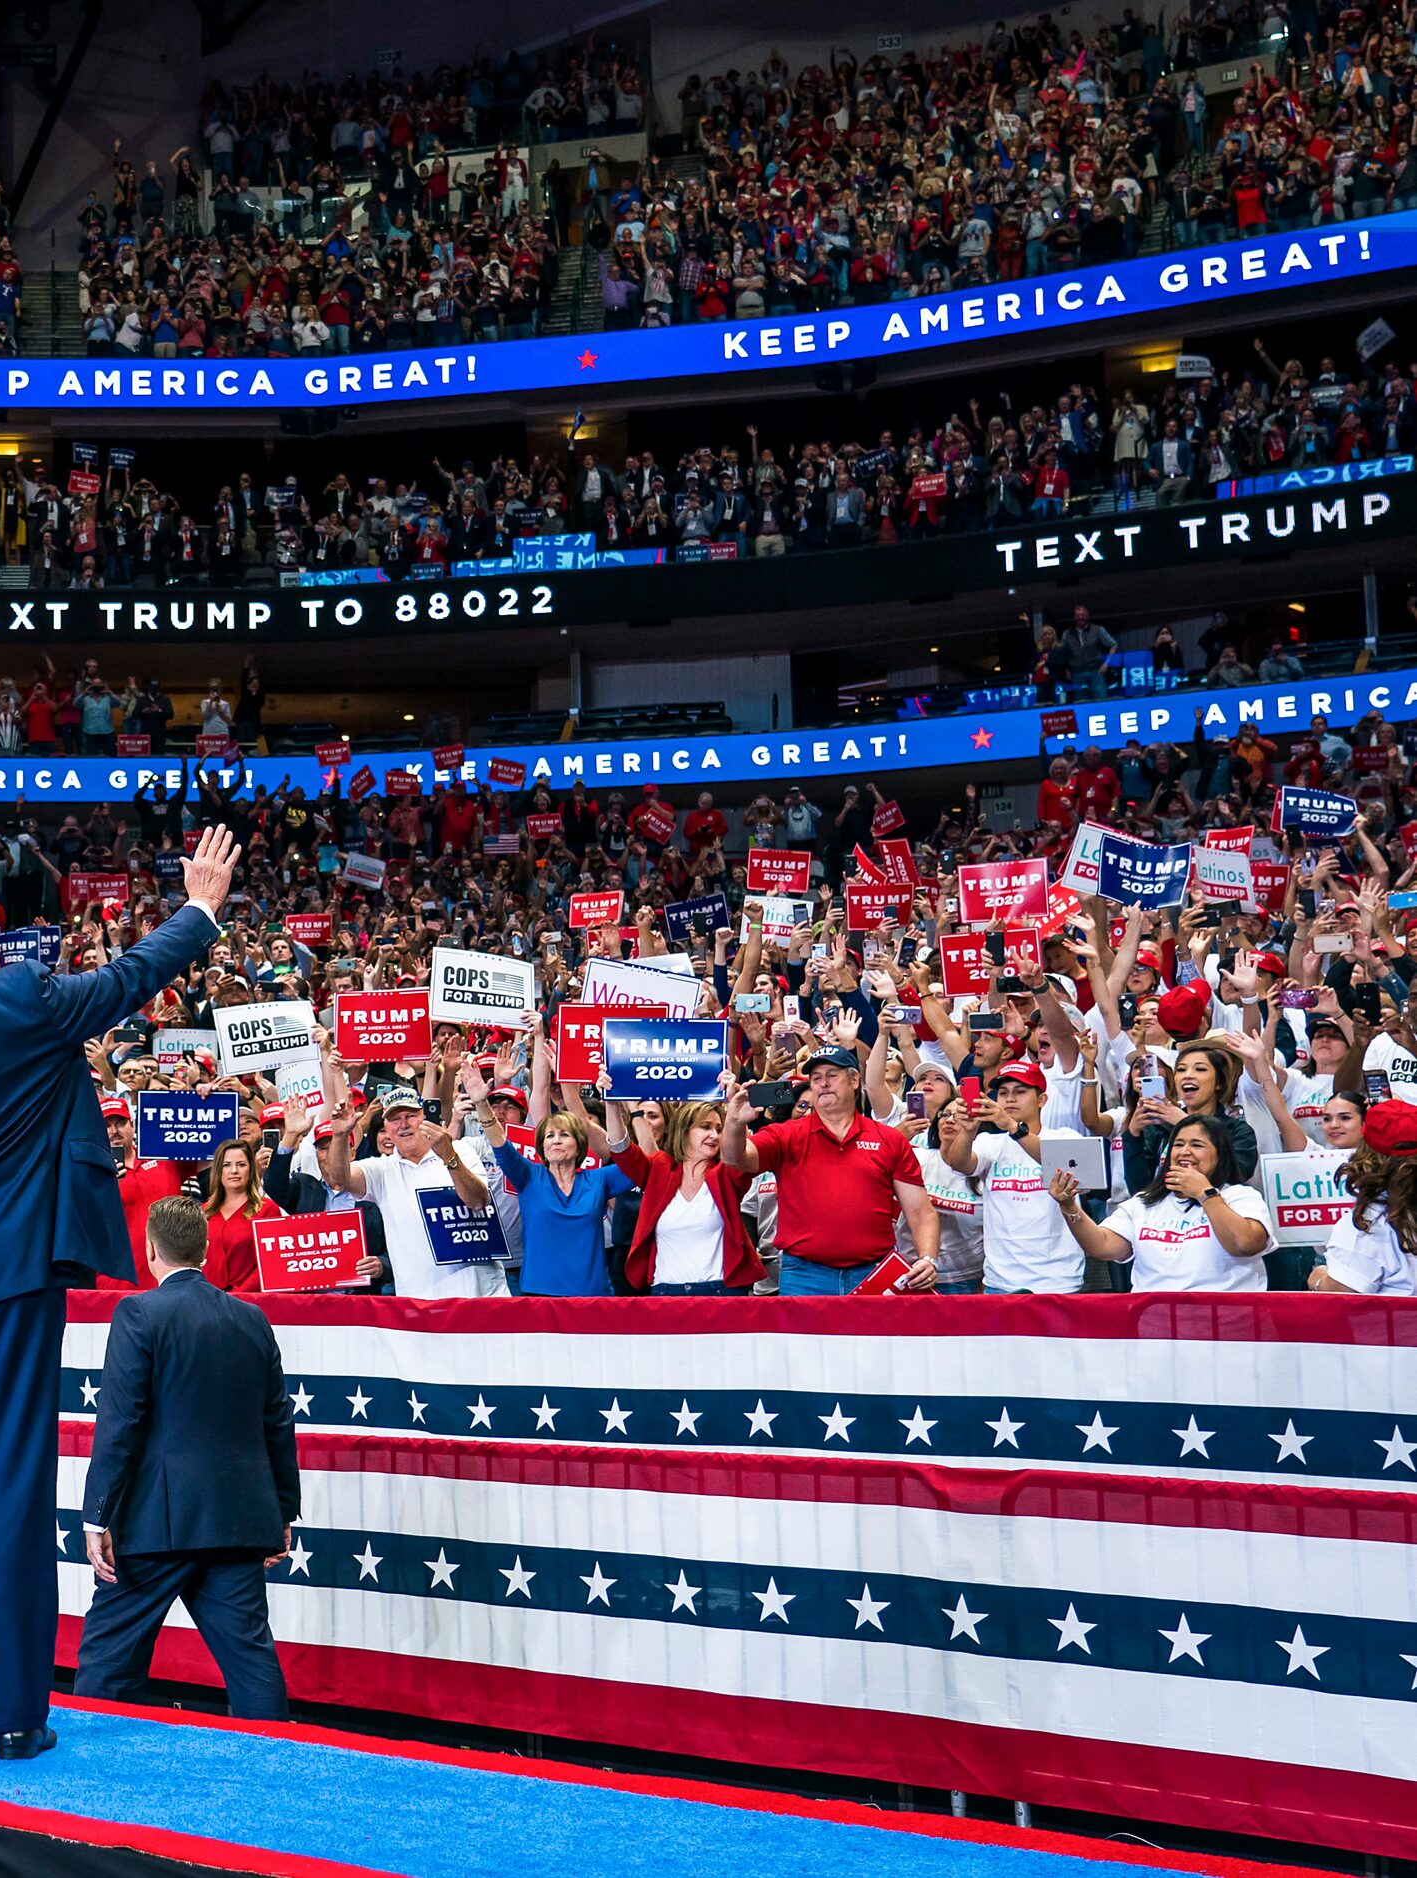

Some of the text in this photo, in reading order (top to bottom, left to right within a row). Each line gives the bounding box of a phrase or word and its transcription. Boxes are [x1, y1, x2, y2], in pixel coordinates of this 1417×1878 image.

[879, 36, 901, 49] 333
[724, 230, 1369, 359] KEEP AMERICA GREAT!
[58, 370, 274, 395] AMERICA
[305, 356, 476, 394] GREAT!
[996, 493, 1390, 572] TEXT TRUMP
[99, 602, 271, 630] TRUMP
[301, 598, 362, 627] TO
[395, 586, 552, 622] 88022
[533, 734, 907, 777] AMERICA GREAT!
[995, 801, 1012, 811] 124
[1286, 796, 1354, 811] TRUMP
[1301, 813, 1338, 824] 2020
[1209, 836, 1251, 850] TRUMP
[752, 859, 806, 870] TRUMP
[1104, 852, 1187, 875] TRUMP
[763, 873, 793, 883] 2020
[964, 873, 1042, 891] TRUMP
[1121, 879, 1165, 894] 2020
[1213, 885, 1246, 898] TRUMP
[573, 899, 618, 910] TRUMP
[850, 894, 910, 905] TRUMP
[983, 894, 1025, 908] 2020
[583, 910, 607, 919] 2020
[289, 920, 331, 931] TRUMP
[298, 931, 321, 940] 2020
[443, 965, 490, 990] COPS
[445, 990, 523, 1007] FOR TRUMP
[340, 1008, 425, 1024] TRUMP
[228, 1017, 272, 1042] COPS
[359, 1032, 406, 1044] 2020
[232, 1041, 260, 1058] FOR
[263, 1034, 310, 1053] TRUMP
[610, 1038, 720, 1054] TRUMP
[635, 1066, 693, 1079] 2020
[143, 1108, 232, 1122] TRUMP
[164, 1131, 211, 1143] 2020
[759, 1184, 776, 1192] FOR
[993, 1181, 1043, 1191] FOR TRUM
[1283, 1208, 1323, 1223] FOR
[261, 1230, 358, 1252] TRUMP
[452, 1229, 489, 1243] 2020
[1141, 1228, 1168, 1240] FOR
[297, 1249, 321, 1257] AMERICA
[321, 1247, 342, 1255] GREAT!
[287, 1256, 338, 1272] 2020
